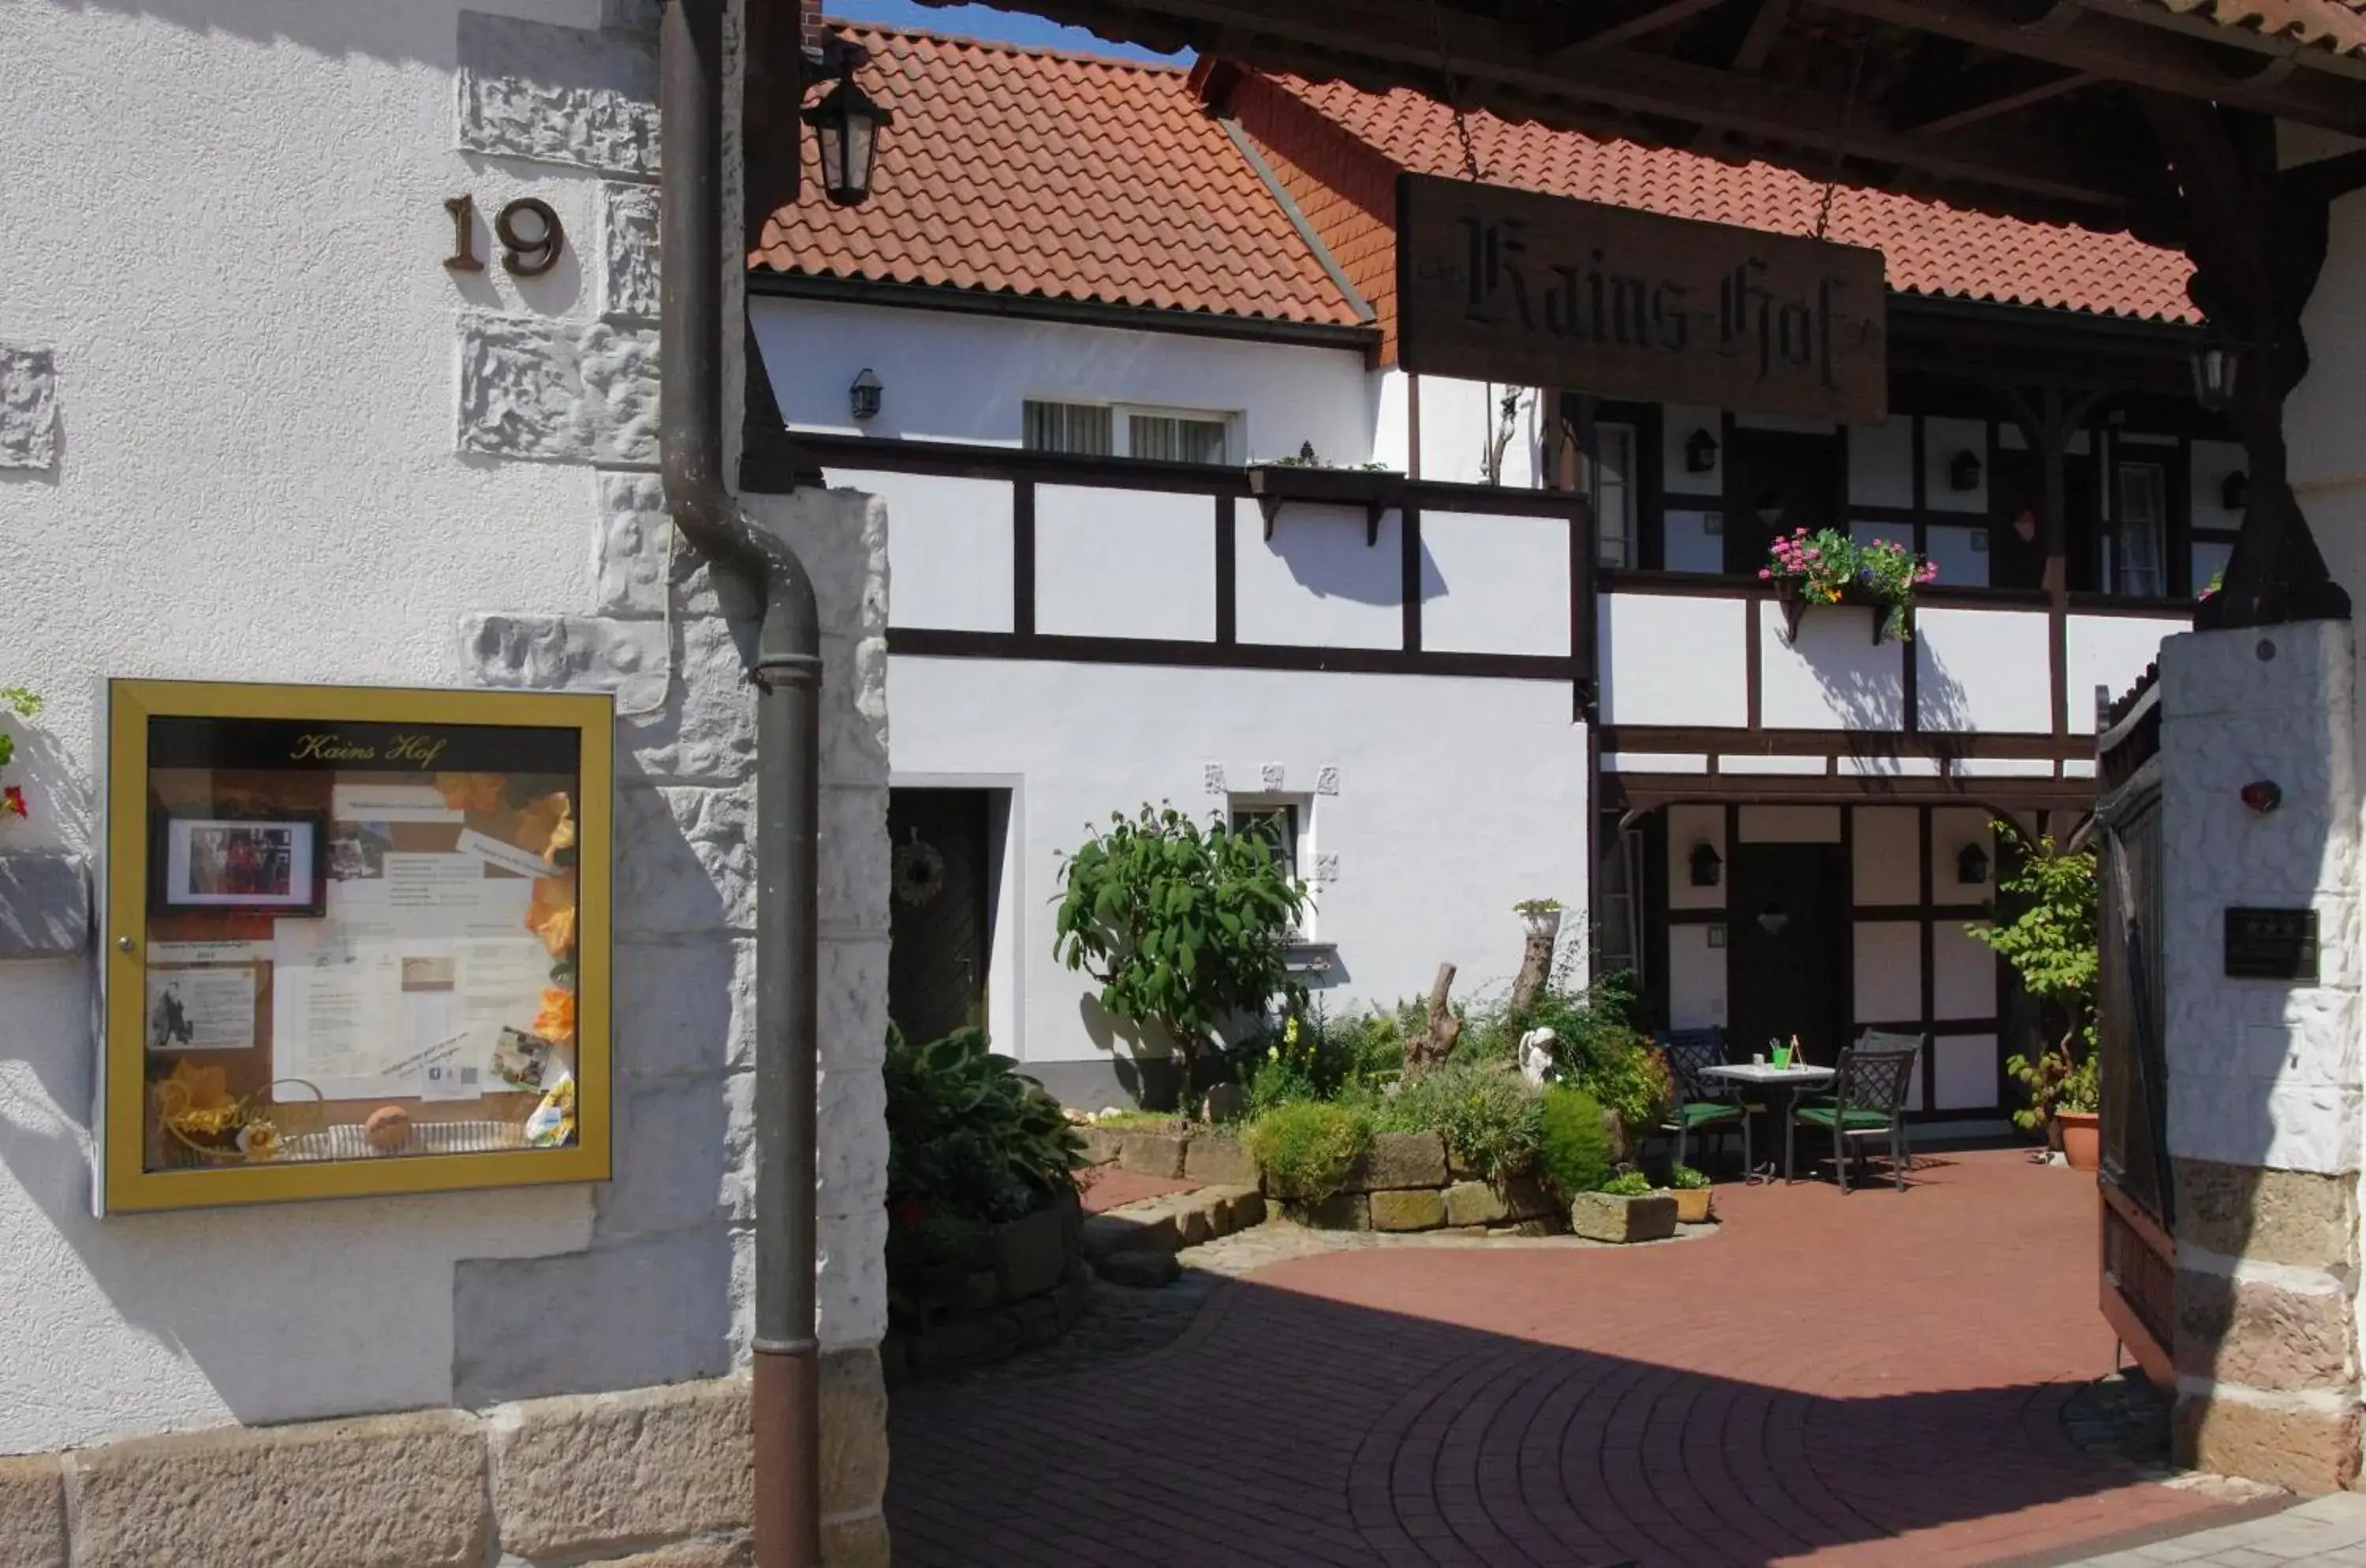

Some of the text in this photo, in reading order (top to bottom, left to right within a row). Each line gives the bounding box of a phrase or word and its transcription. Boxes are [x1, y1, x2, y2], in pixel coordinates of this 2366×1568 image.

[443, 193, 563, 277] 19
[290, 734, 447, 769] Kains Hof
